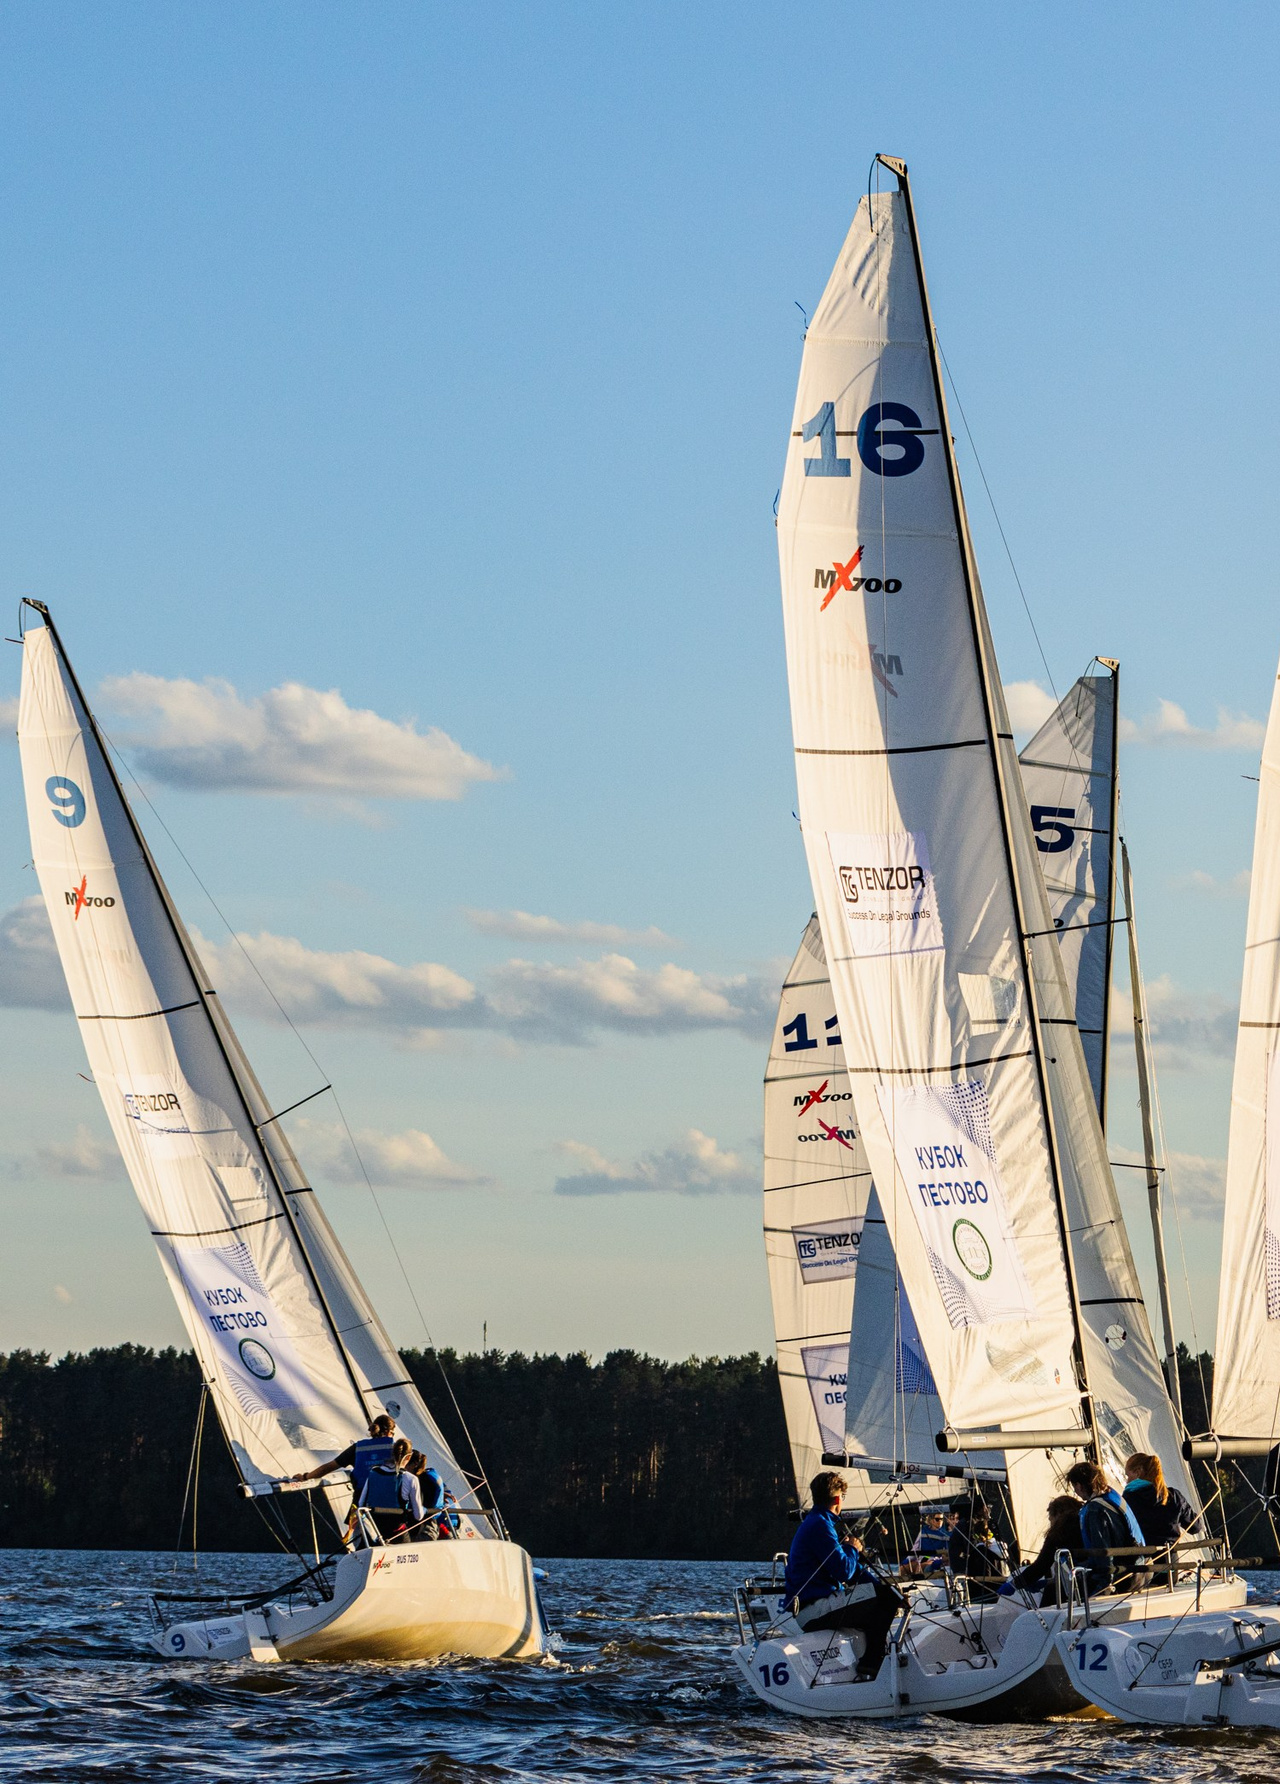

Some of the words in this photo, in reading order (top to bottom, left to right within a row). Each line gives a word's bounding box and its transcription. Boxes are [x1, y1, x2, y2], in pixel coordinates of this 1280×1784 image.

[802, 402, 925, 477] 16
[814, 545, 903, 612] MX700
[45, 775, 87, 828] 9
[1030, 805, 1075, 853] 5
[855, 866, 925, 890] TENZOR
[64, 874, 116, 921] MX700
[896, 908, 931, 920] Grounds
[793, 1079, 853, 1117] MX700
[915, 1145, 968, 1170] КУБОК
[918, 1180, 989, 1207] ПЕСТОВО
[203, 1287, 248, 1306] КУБОК
[209, 1311, 267, 1333] ПЕСТОВО
[171, 1634, 186, 1652] 9
[1076, 1643, 1108, 1671] 12
[759, 1662, 790, 1688] 16
